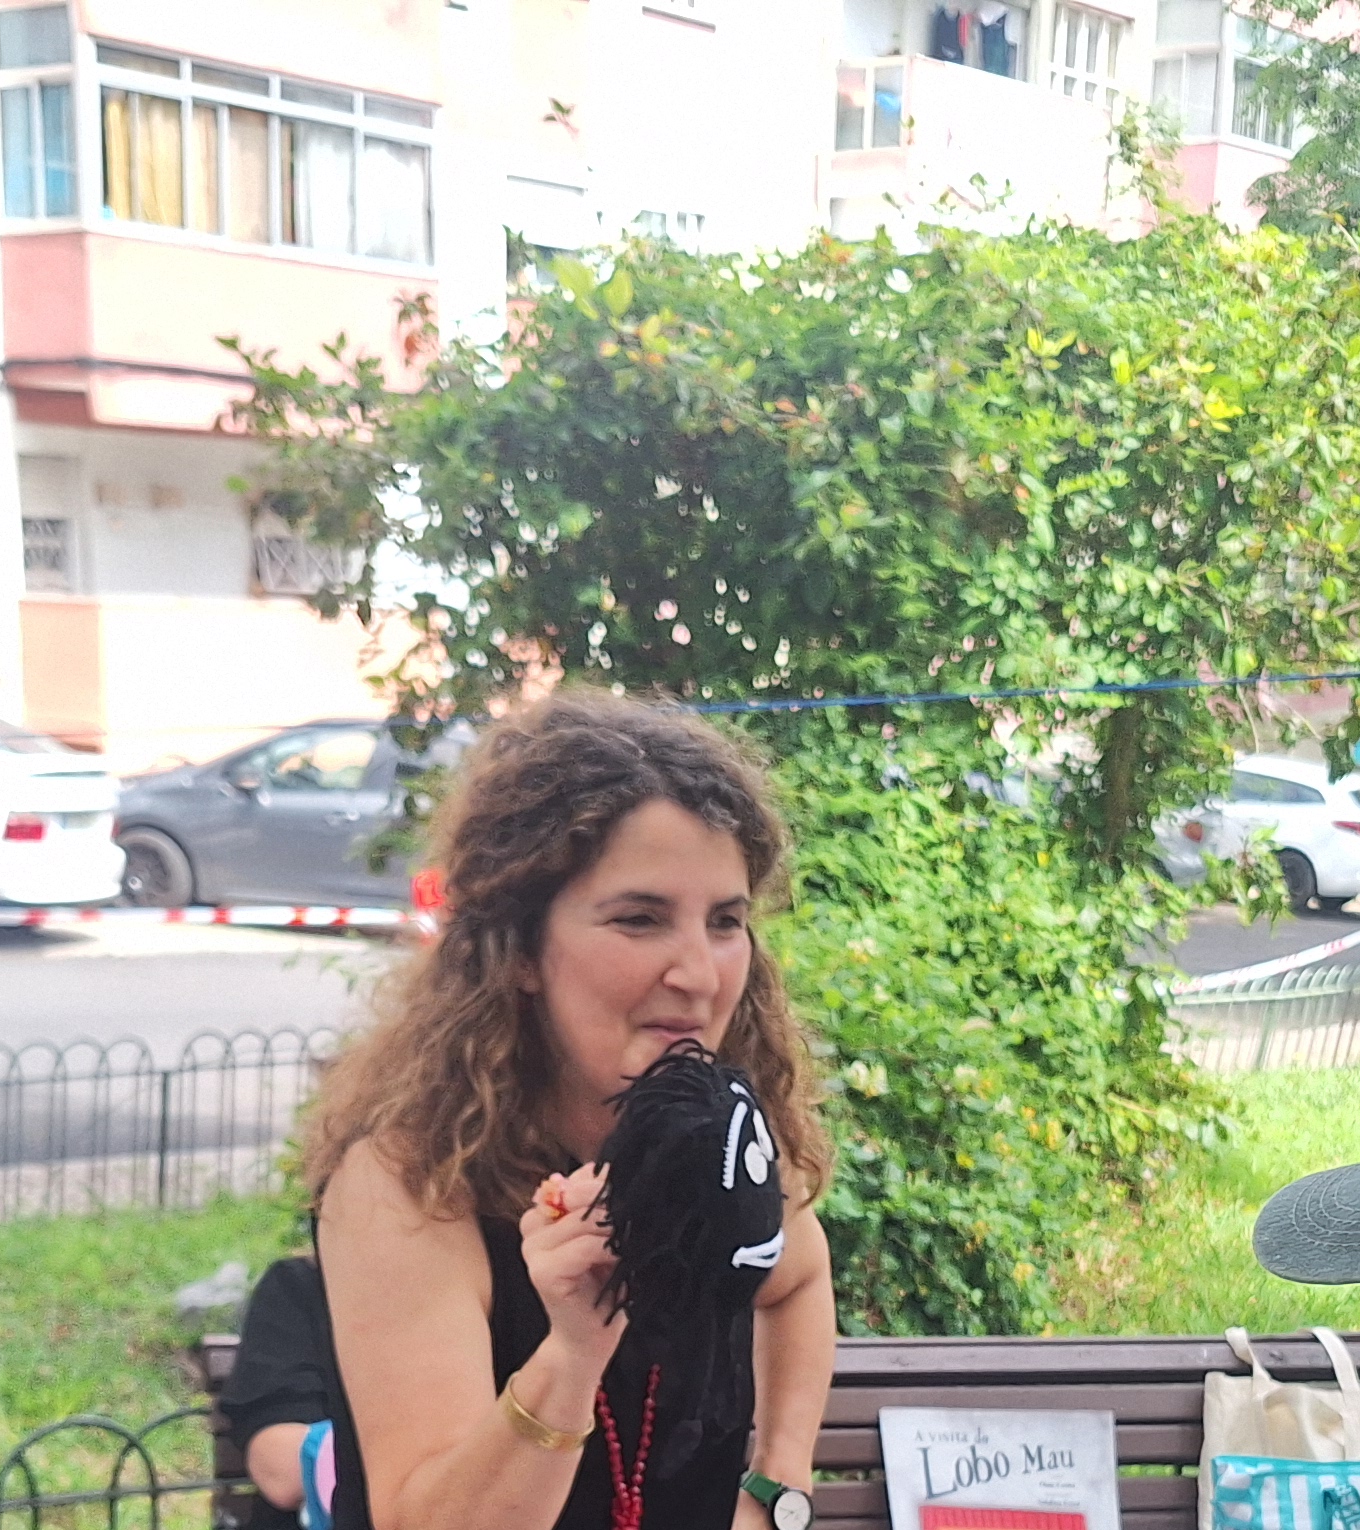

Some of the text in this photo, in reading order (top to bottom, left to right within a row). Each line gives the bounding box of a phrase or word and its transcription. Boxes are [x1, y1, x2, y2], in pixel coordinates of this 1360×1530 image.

[914, 1430, 924, 1442] A
[975, 1427, 990, 1444] do
[916, 1443, 1076, 1500] Lobo Mau
